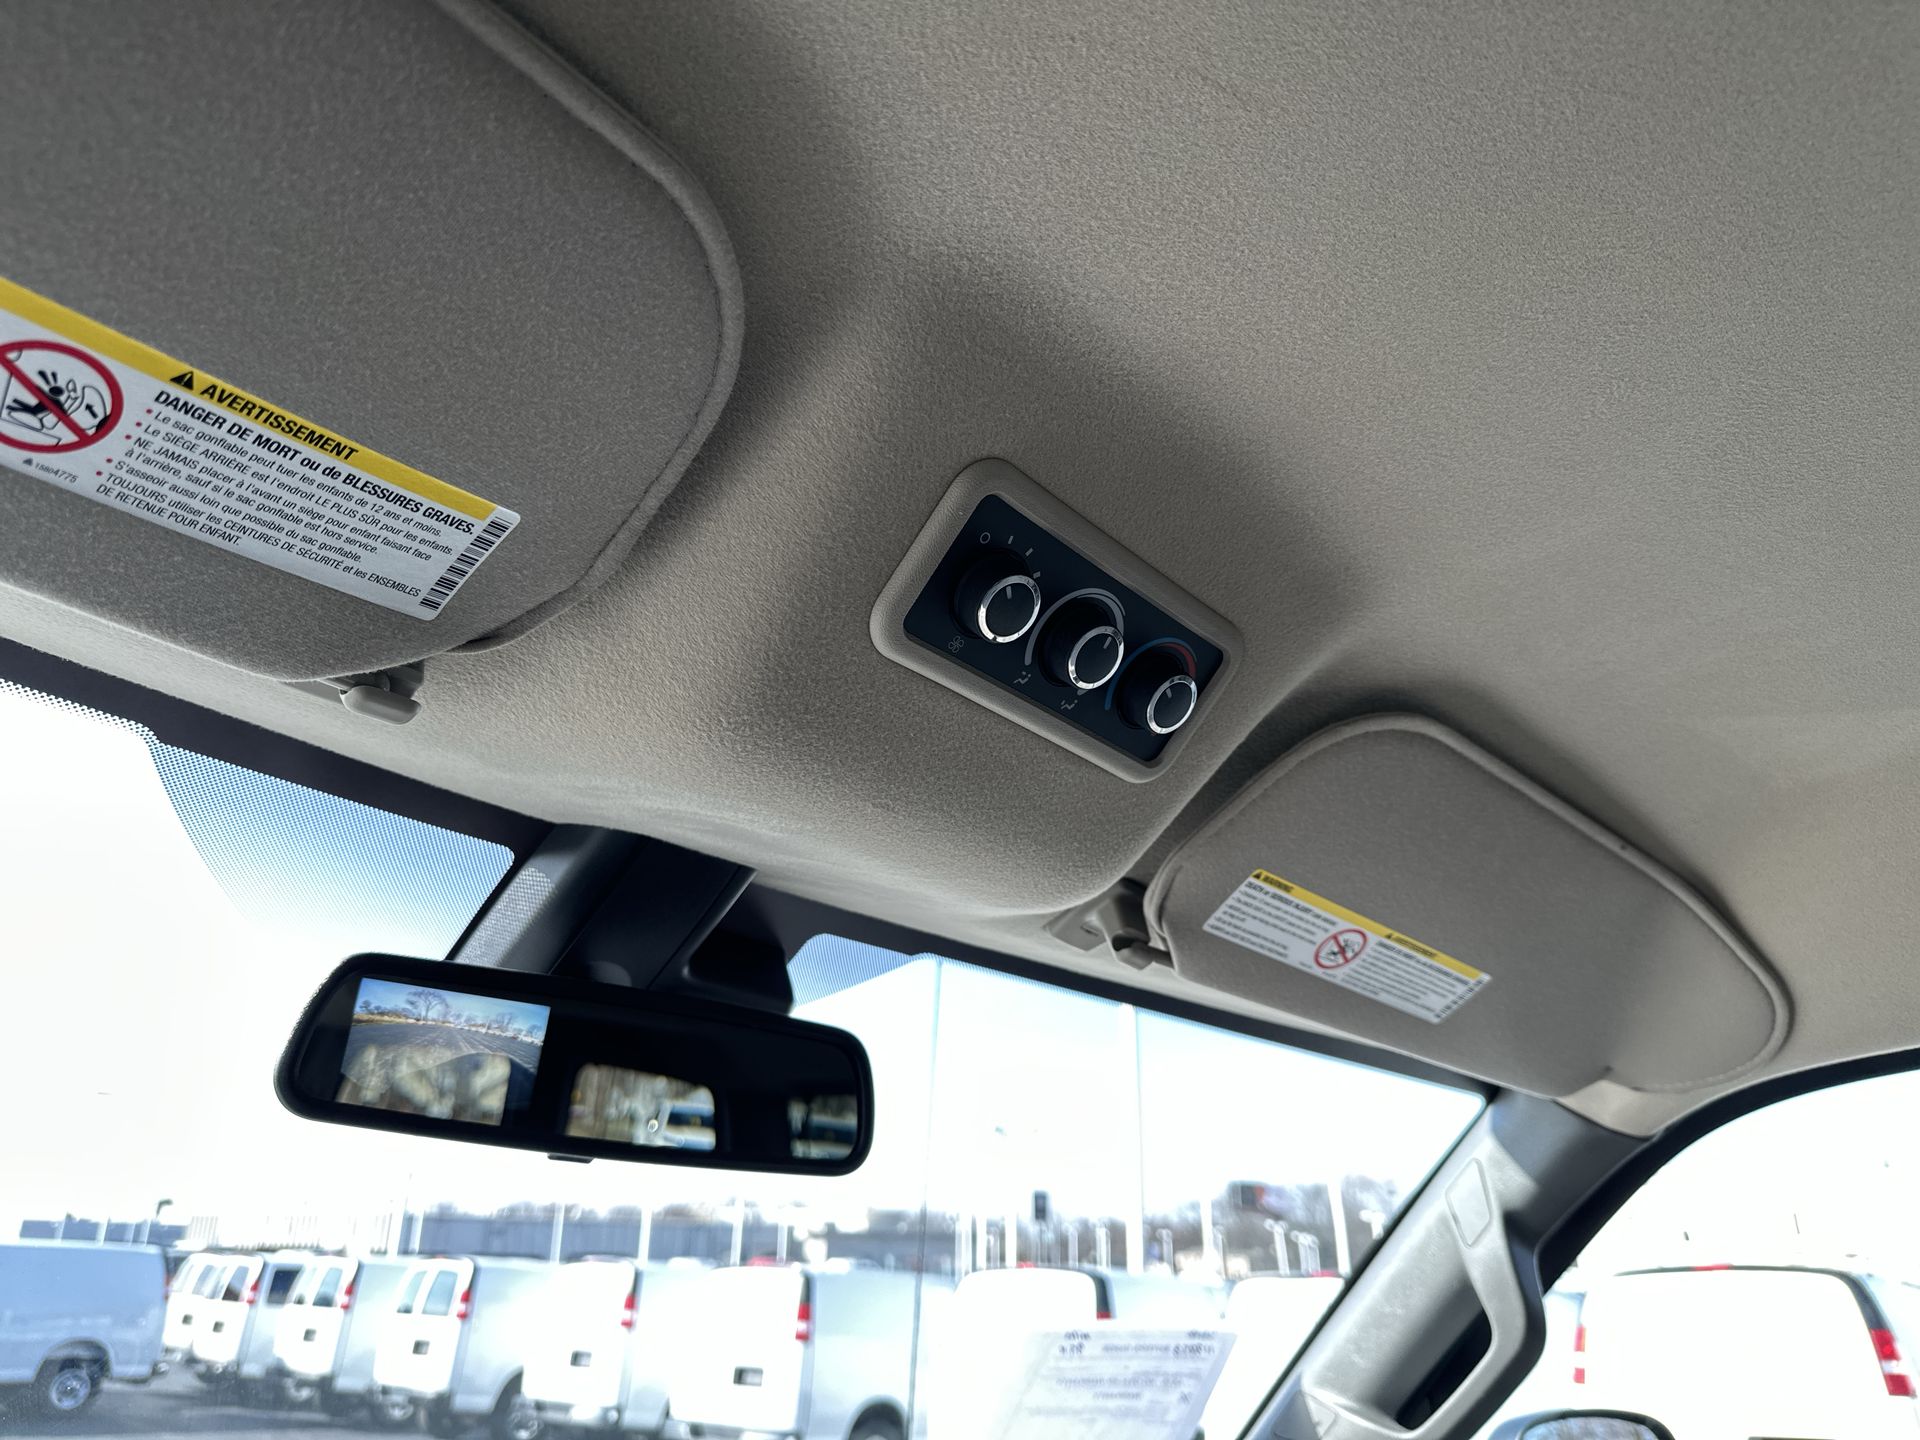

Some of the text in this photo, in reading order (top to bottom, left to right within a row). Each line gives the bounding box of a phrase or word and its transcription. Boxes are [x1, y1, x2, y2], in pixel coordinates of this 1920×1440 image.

[154, 390, 475, 535] DANGER DE MORT ou de BLESSURES GRAVES.
[154, 411, 442, 537] Le sac gonflable peut tuer les enfants de 12 ans et moins.
[200, 384, 358, 460] AVERTISSEMENT
[96, 483, 242, 545] DE RETENUE POUR ENFANT.
[106, 473, 168, 504] TOUJOURS
[167, 499, 206, 518] utiliser
[205, 512, 223, 525] les
[223, 519, 281, 547] CEINTURES
[280, 541, 298, 553] DE
[342, 565, 354, 574] et
[352, 567, 368, 579] les
[367, 573, 421, 597] ENSEMBLES
[124, 447, 135, 458] à
[185, 474, 213, 489] sauf
[211, 484, 225, 494] si
[223, 487, 235, 499] le
[235, 494, 256, 507] sac
[255, 503, 304, 525] gonflable
[303, 521, 322, 532] est
[320, 526, 344, 541] hors
[343, 536, 378, 554] service.
[133, 436, 154, 451] NE
[153, 446, 200, 470] JAMAIS
[198, 465, 236, 484] placer
[235, 479, 245, 489] à
[282, 499, 298, 510] un
[297, 506, 326, 521] siège
[324, 517, 350, 530] pour
[349, 526, 381, 542] enfant
[380, 536, 413, 554] faisant
[411, 548, 432, 561] face
[143, 424, 161, 437] Le
[250, 471, 271, 483] est
[314, 495, 332, 508] LE
[329, 502, 359, 519] PLUS
[378, 523, 404, 536] pour
[403, 530, 419, 542] les
[418, 537, 453, 556] enfants.
[168, 484, 201, 500] aussi
[199, 494, 221, 509] loin
[221, 504, 242, 517] que
[241, 512, 285, 534] possible
[285, 529, 300, 540] du
[299, 535, 319, 547] sac
[317, 542, 361, 563] gonflable.
